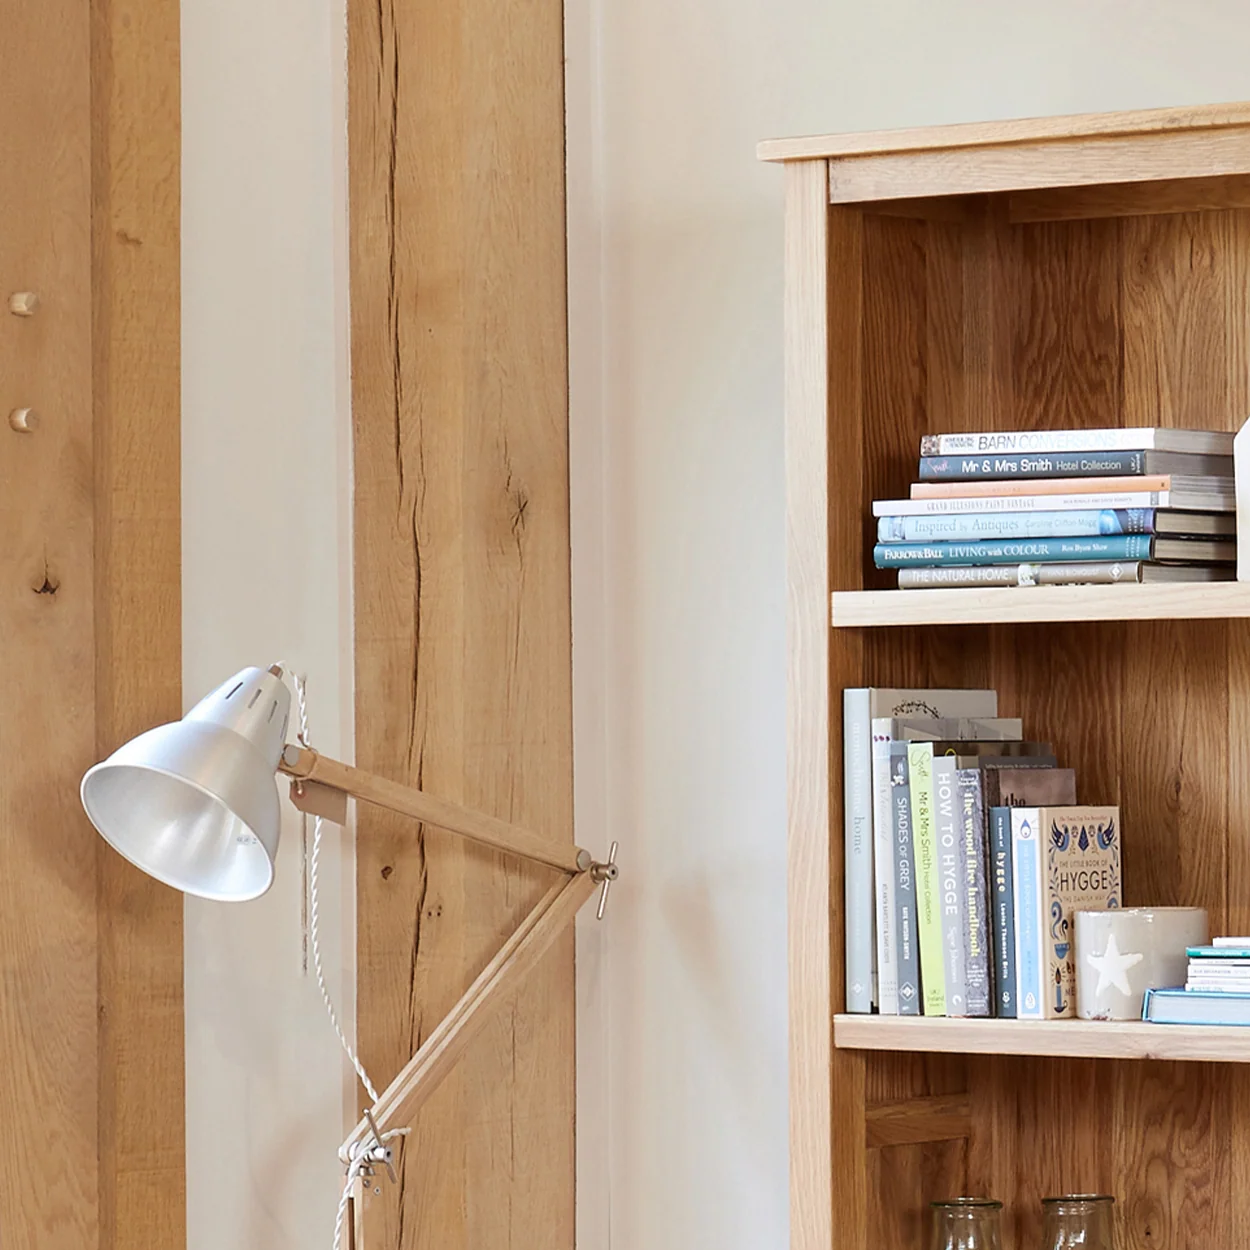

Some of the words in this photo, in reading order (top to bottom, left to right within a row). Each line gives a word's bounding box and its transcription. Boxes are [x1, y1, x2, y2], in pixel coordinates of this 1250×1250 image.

[978, 435, 1016, 450] BARN
[961, 460, 979, 473] Mr
[982, 459, 991, 472] &
[995, 459, 1018, 472] Mrs
[1020, 458, 1053, 472] Smith
[1056, 460, 1079, 471] Hotel
[1081, 459, 1122, 471] Collection
[914, 519, 957, 535] Inspired
[971, 518, 1019, 534] Antiques
[948, 546, 986, 558] LIVING
[1003, 544, 1050, 556] COLOUR
[912, 570, 930, 582] THE
[931, 569, 975, 582] NATURAL
[918, 791, 928, 805] Mr
[937, 772, 953, 816] HOW
[963, 792, 976, 818] the
[897, 797, 908, 843] SHADES
[920, 807, 930, 816] &
[853, 816, 864, 855] home
[920, 817, 931, 837] Mrs
[940, 823, 954, 848] TO
[965, 819, 977, 856] wood
[900, 846, 908, 857] OF
[921, 838, 933, 870] Smith
[899, 860, 910, 891] GREY
[966, 859, 977, 884] fire
[995, 852, 1008, 892] hygge
[1060, 869, 1108, 892] HYGGE
[943, 855, 958, 916] HYGGE
[967, 887, 981, 957] handbook
